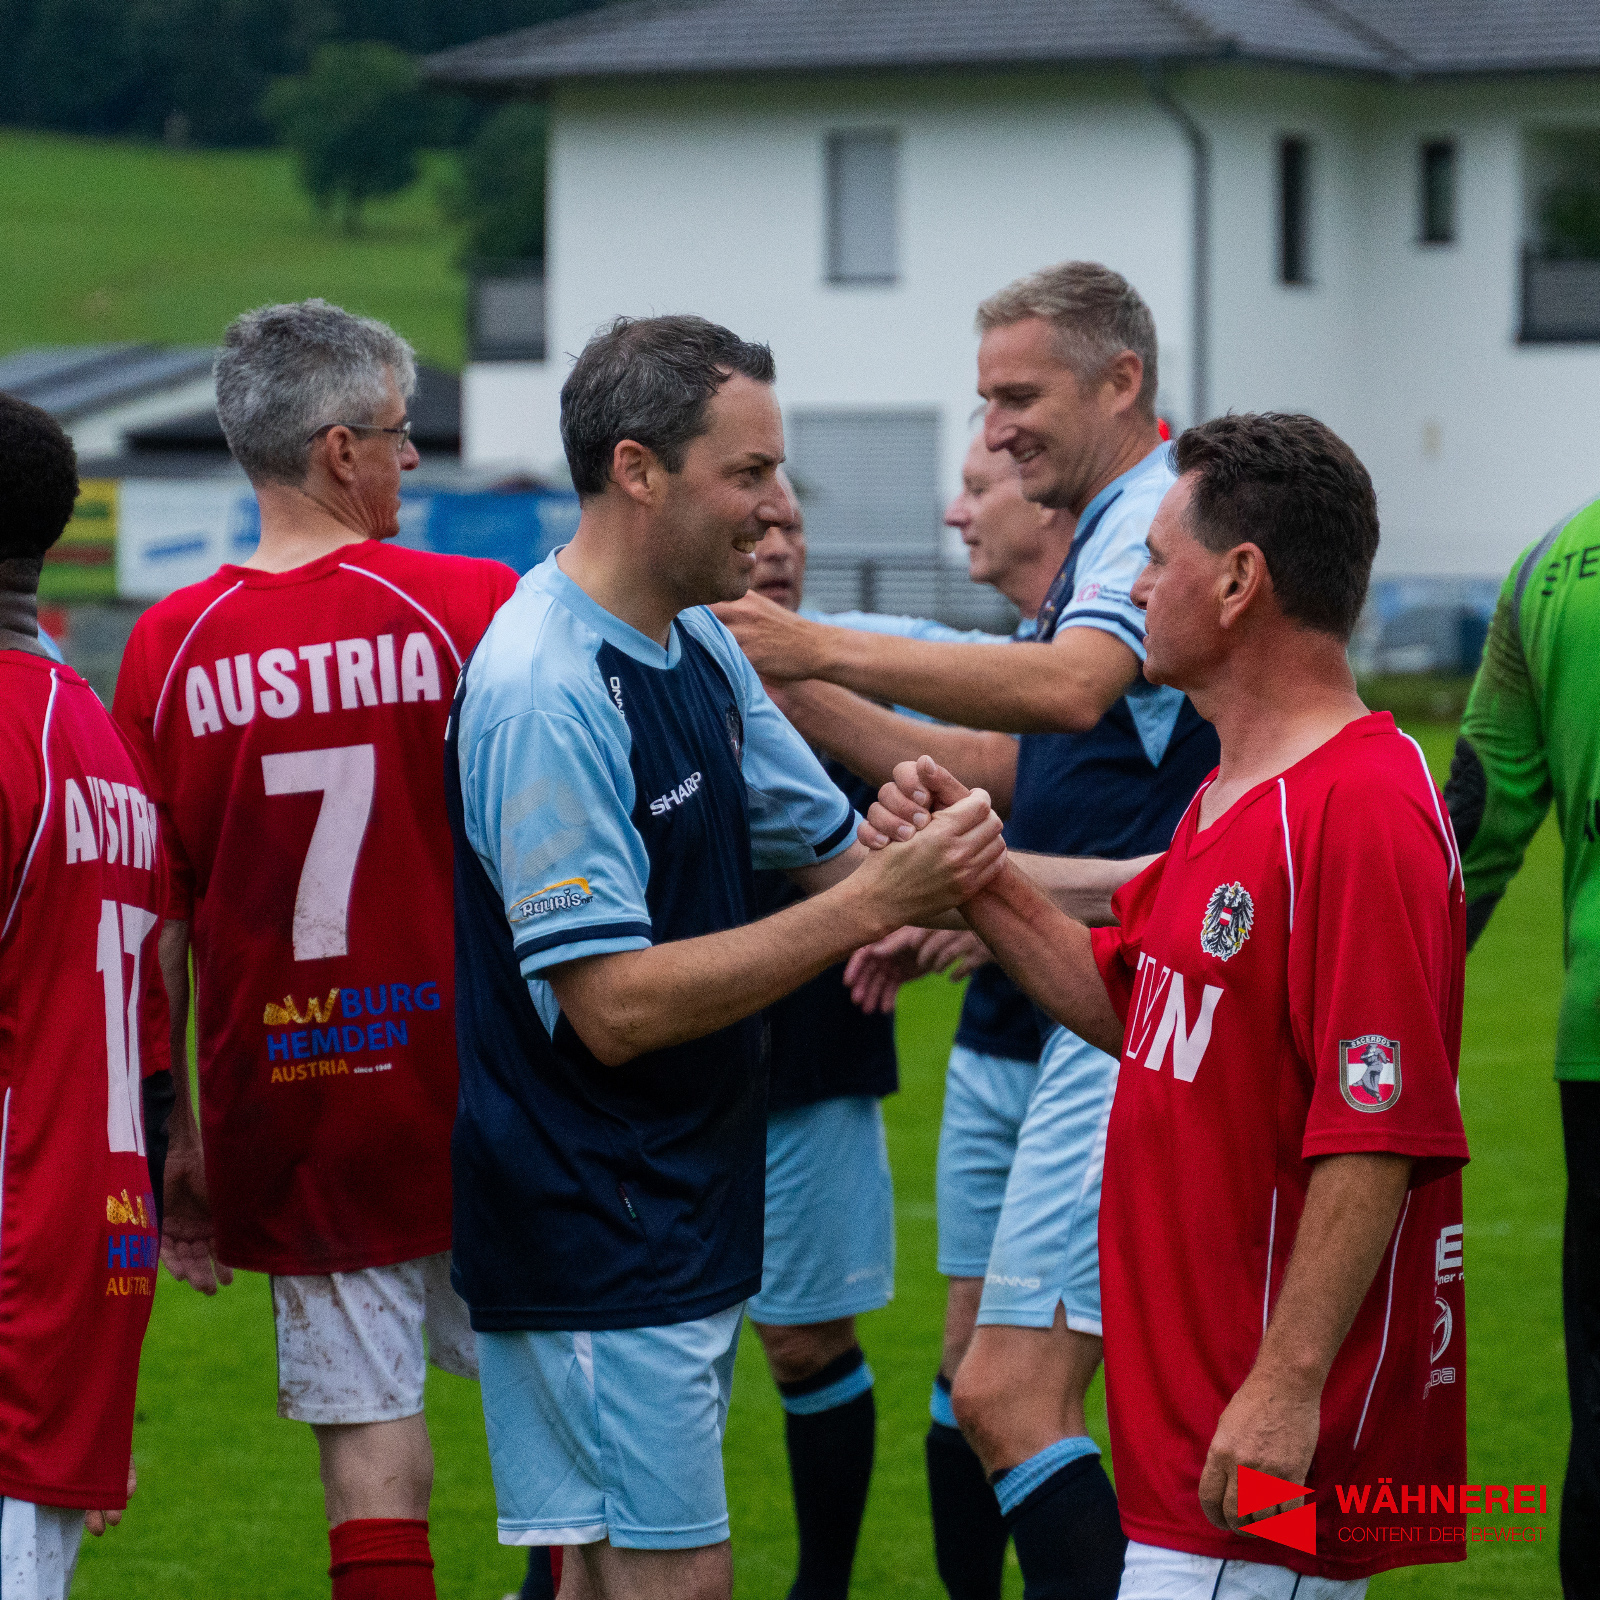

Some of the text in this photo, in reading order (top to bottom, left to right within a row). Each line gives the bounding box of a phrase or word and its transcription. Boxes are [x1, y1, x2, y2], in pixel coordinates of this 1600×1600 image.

[185, 632, 442, 738] AUSTRIA
[650, 771, 702, 816] SHARP
[261, 743, 376, 962] 7
[96, 899, 158, 1157] 17
[267, 1020, 409, 1061] HEMDEN
[1351, 1035, 1391, 1049] SACERDOS
[271, 1059, 350, 1084] AUSTRIA
